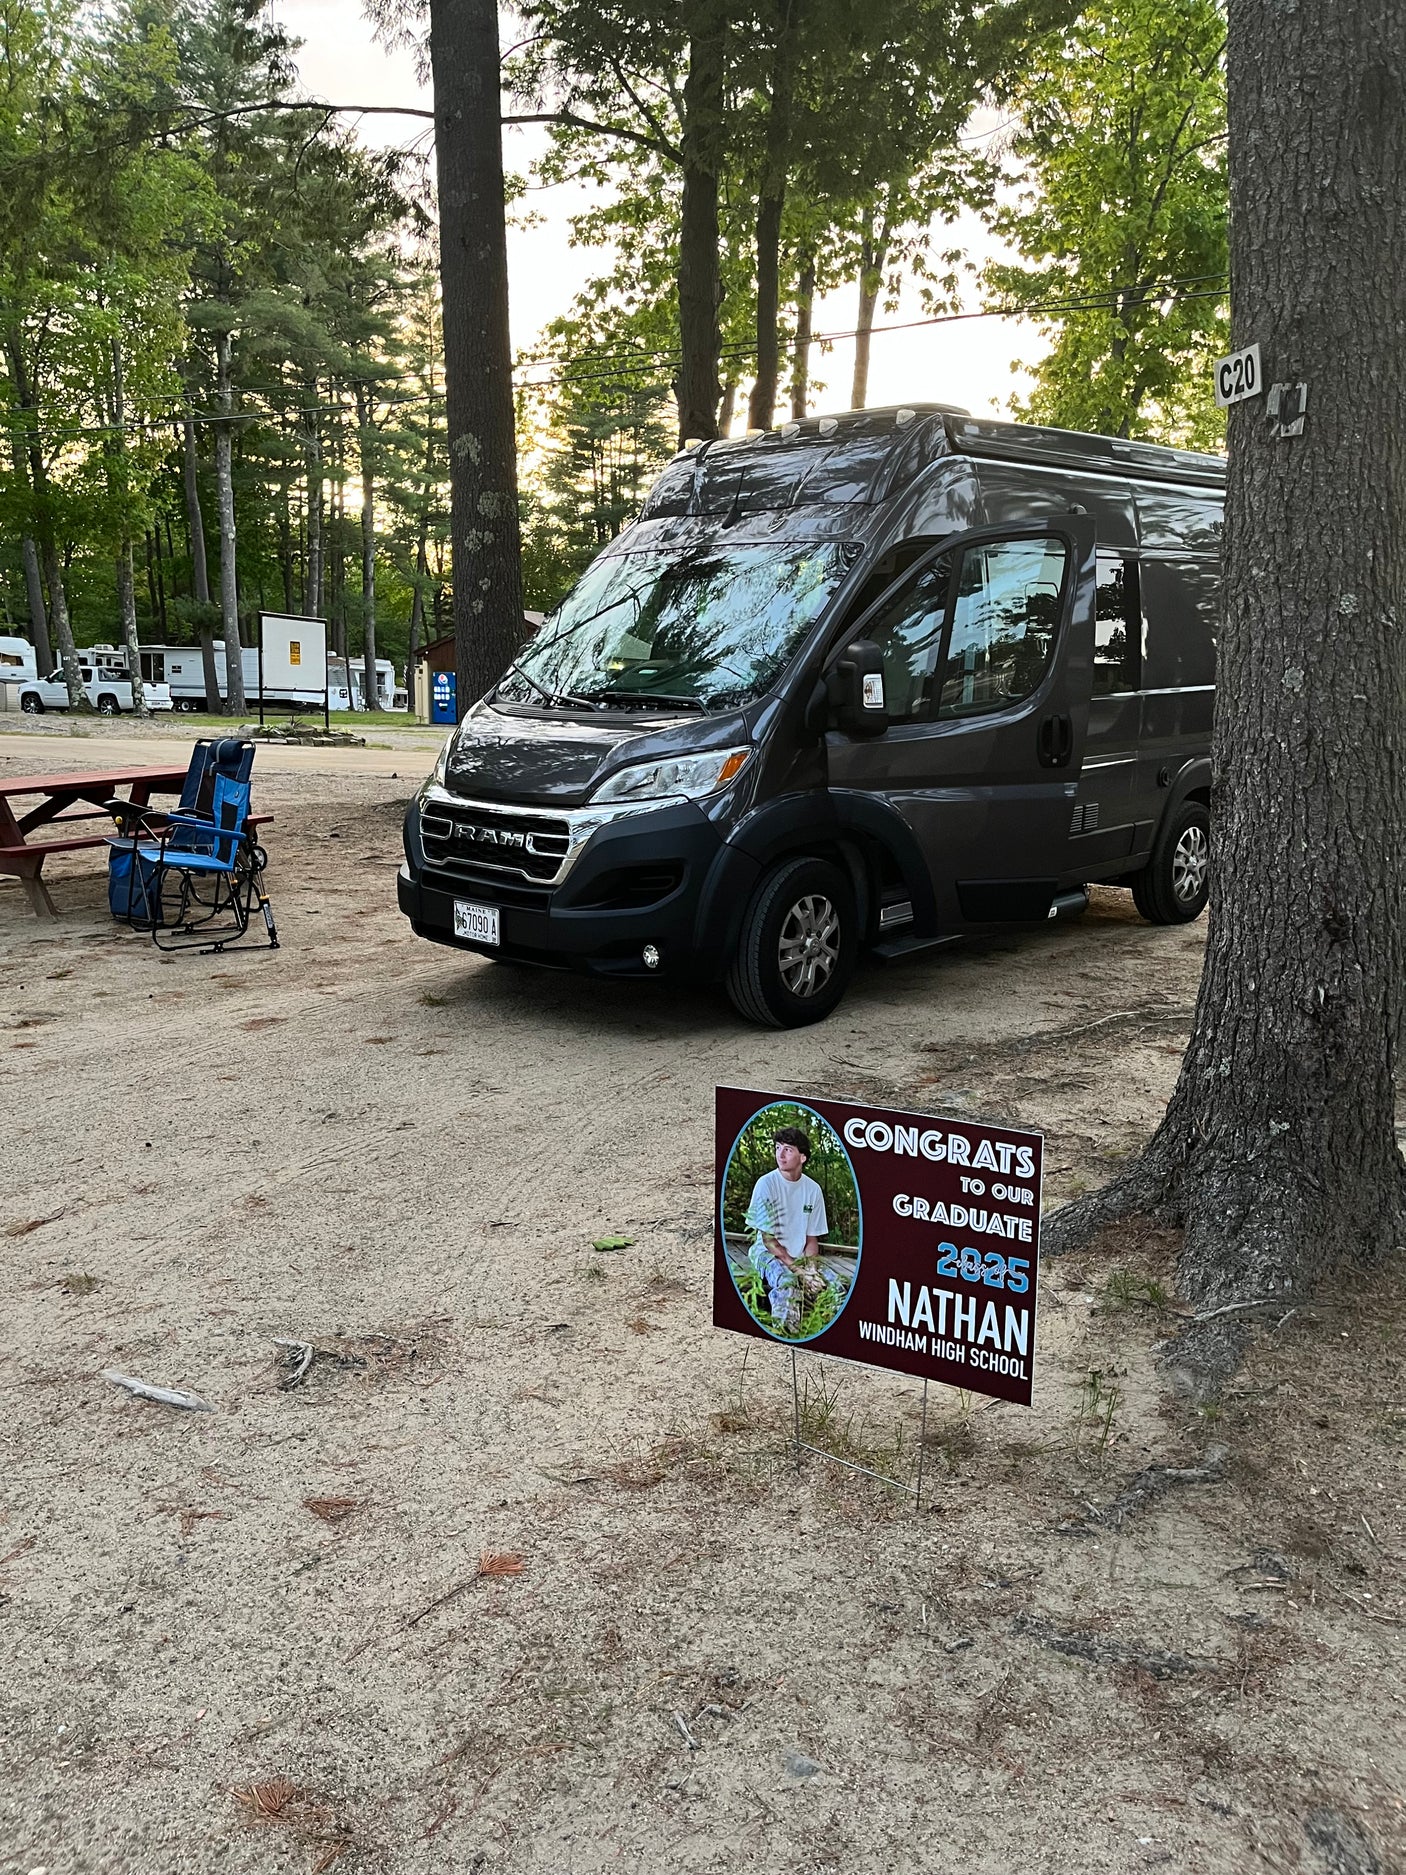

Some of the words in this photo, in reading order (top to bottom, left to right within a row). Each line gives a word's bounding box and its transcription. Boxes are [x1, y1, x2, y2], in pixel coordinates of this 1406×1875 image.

[1219, 353, 1255, 399] C20
[454, 823, 525, 848] RAM
[462, 912, 489, 934] 67090
[491, 918, 497, 936] A
[466, 906, 486, 915] MAINE
[843, 1117, 1036, 1179] CONGRATS
[959, 1176, 986, 1196] TO
[991, 1183, 1035, 1206] OUR
[892, 1193, 1033, 1243] GRADUATE
[936, 1241, 1031, 1294] 2025
[887, 1277, 1029, 1357] NATHAN
[858, 1319, 928, 1354] WINDHAM
[931, 1337, 966, 1364] HIGH
[969, 1347, 1029, 1381] SCHOOL
